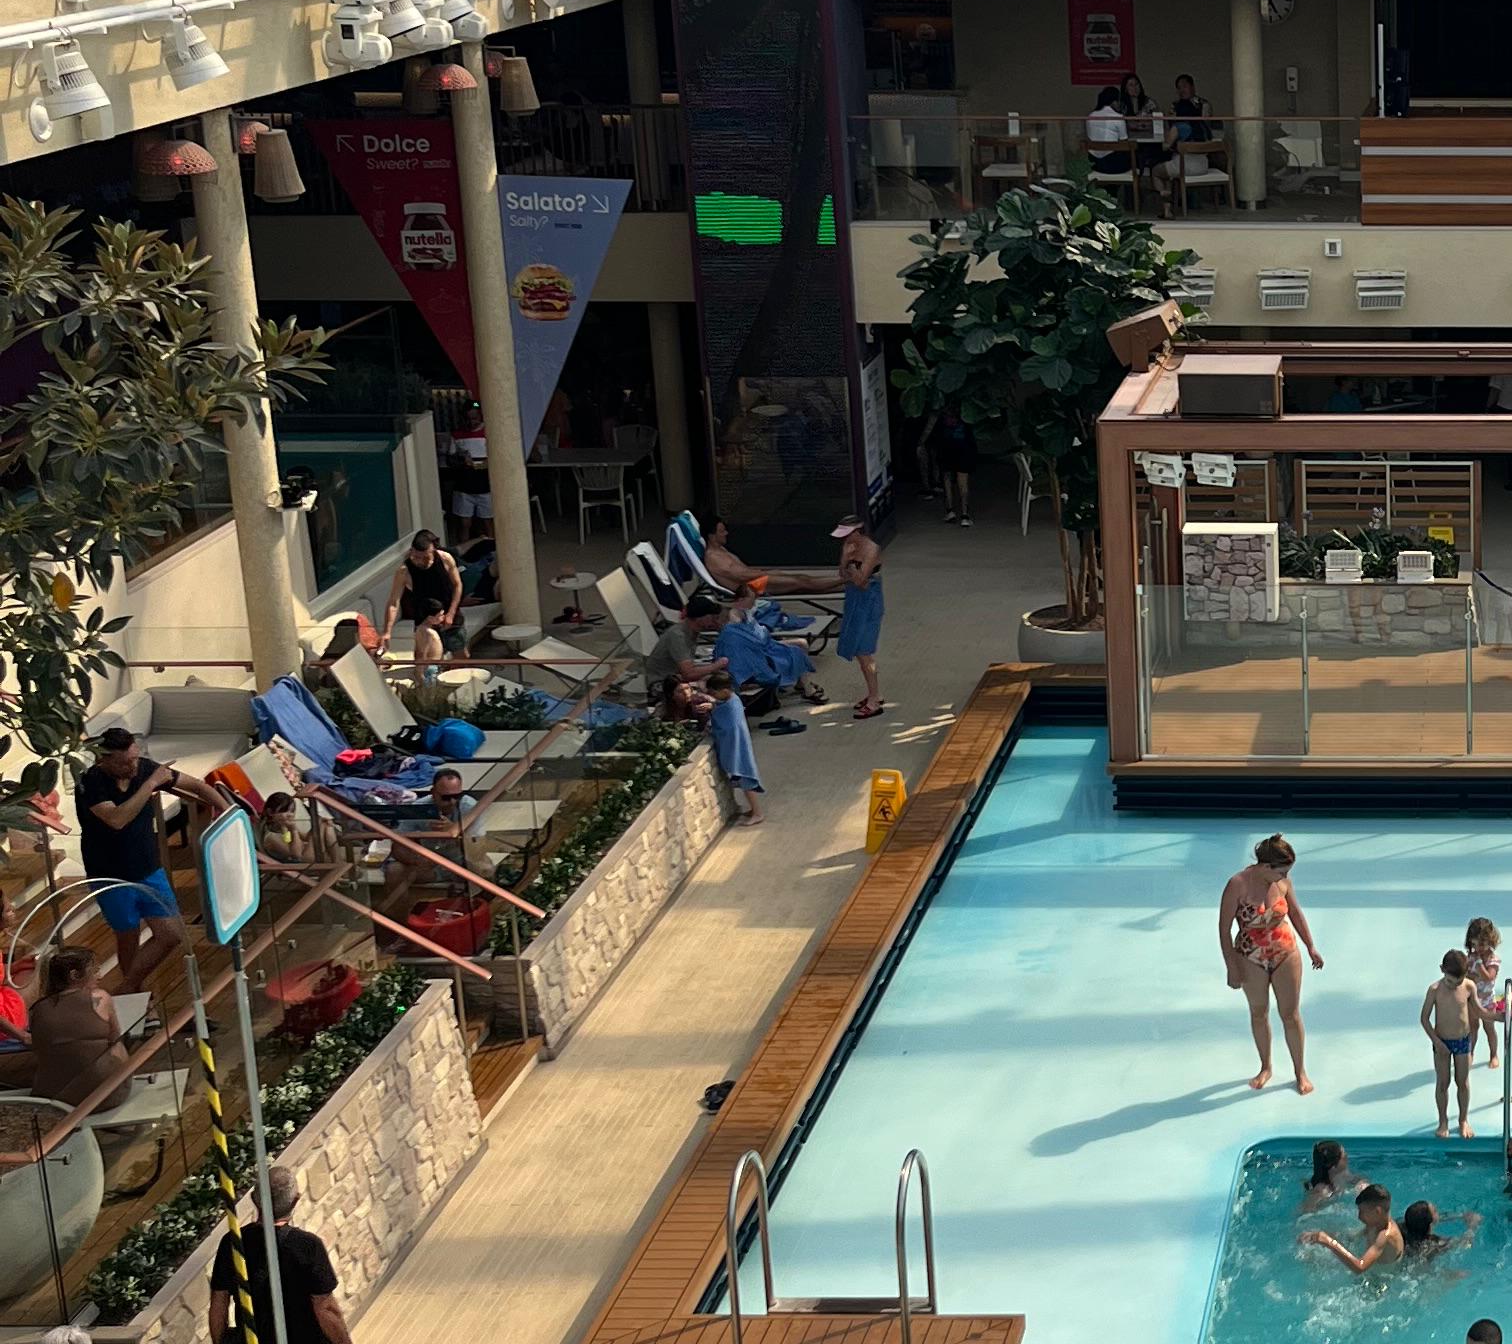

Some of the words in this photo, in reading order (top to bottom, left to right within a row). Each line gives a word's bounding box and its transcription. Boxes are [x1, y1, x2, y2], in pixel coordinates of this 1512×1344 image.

[362, 134, 430, 153] Dolce
[366, 158, 419, 170] Sweet?
[506, 192, 587, 212] Salato?
[509, 215, 549, 230] Salty?
[404, 232, 452, 246] nutella
